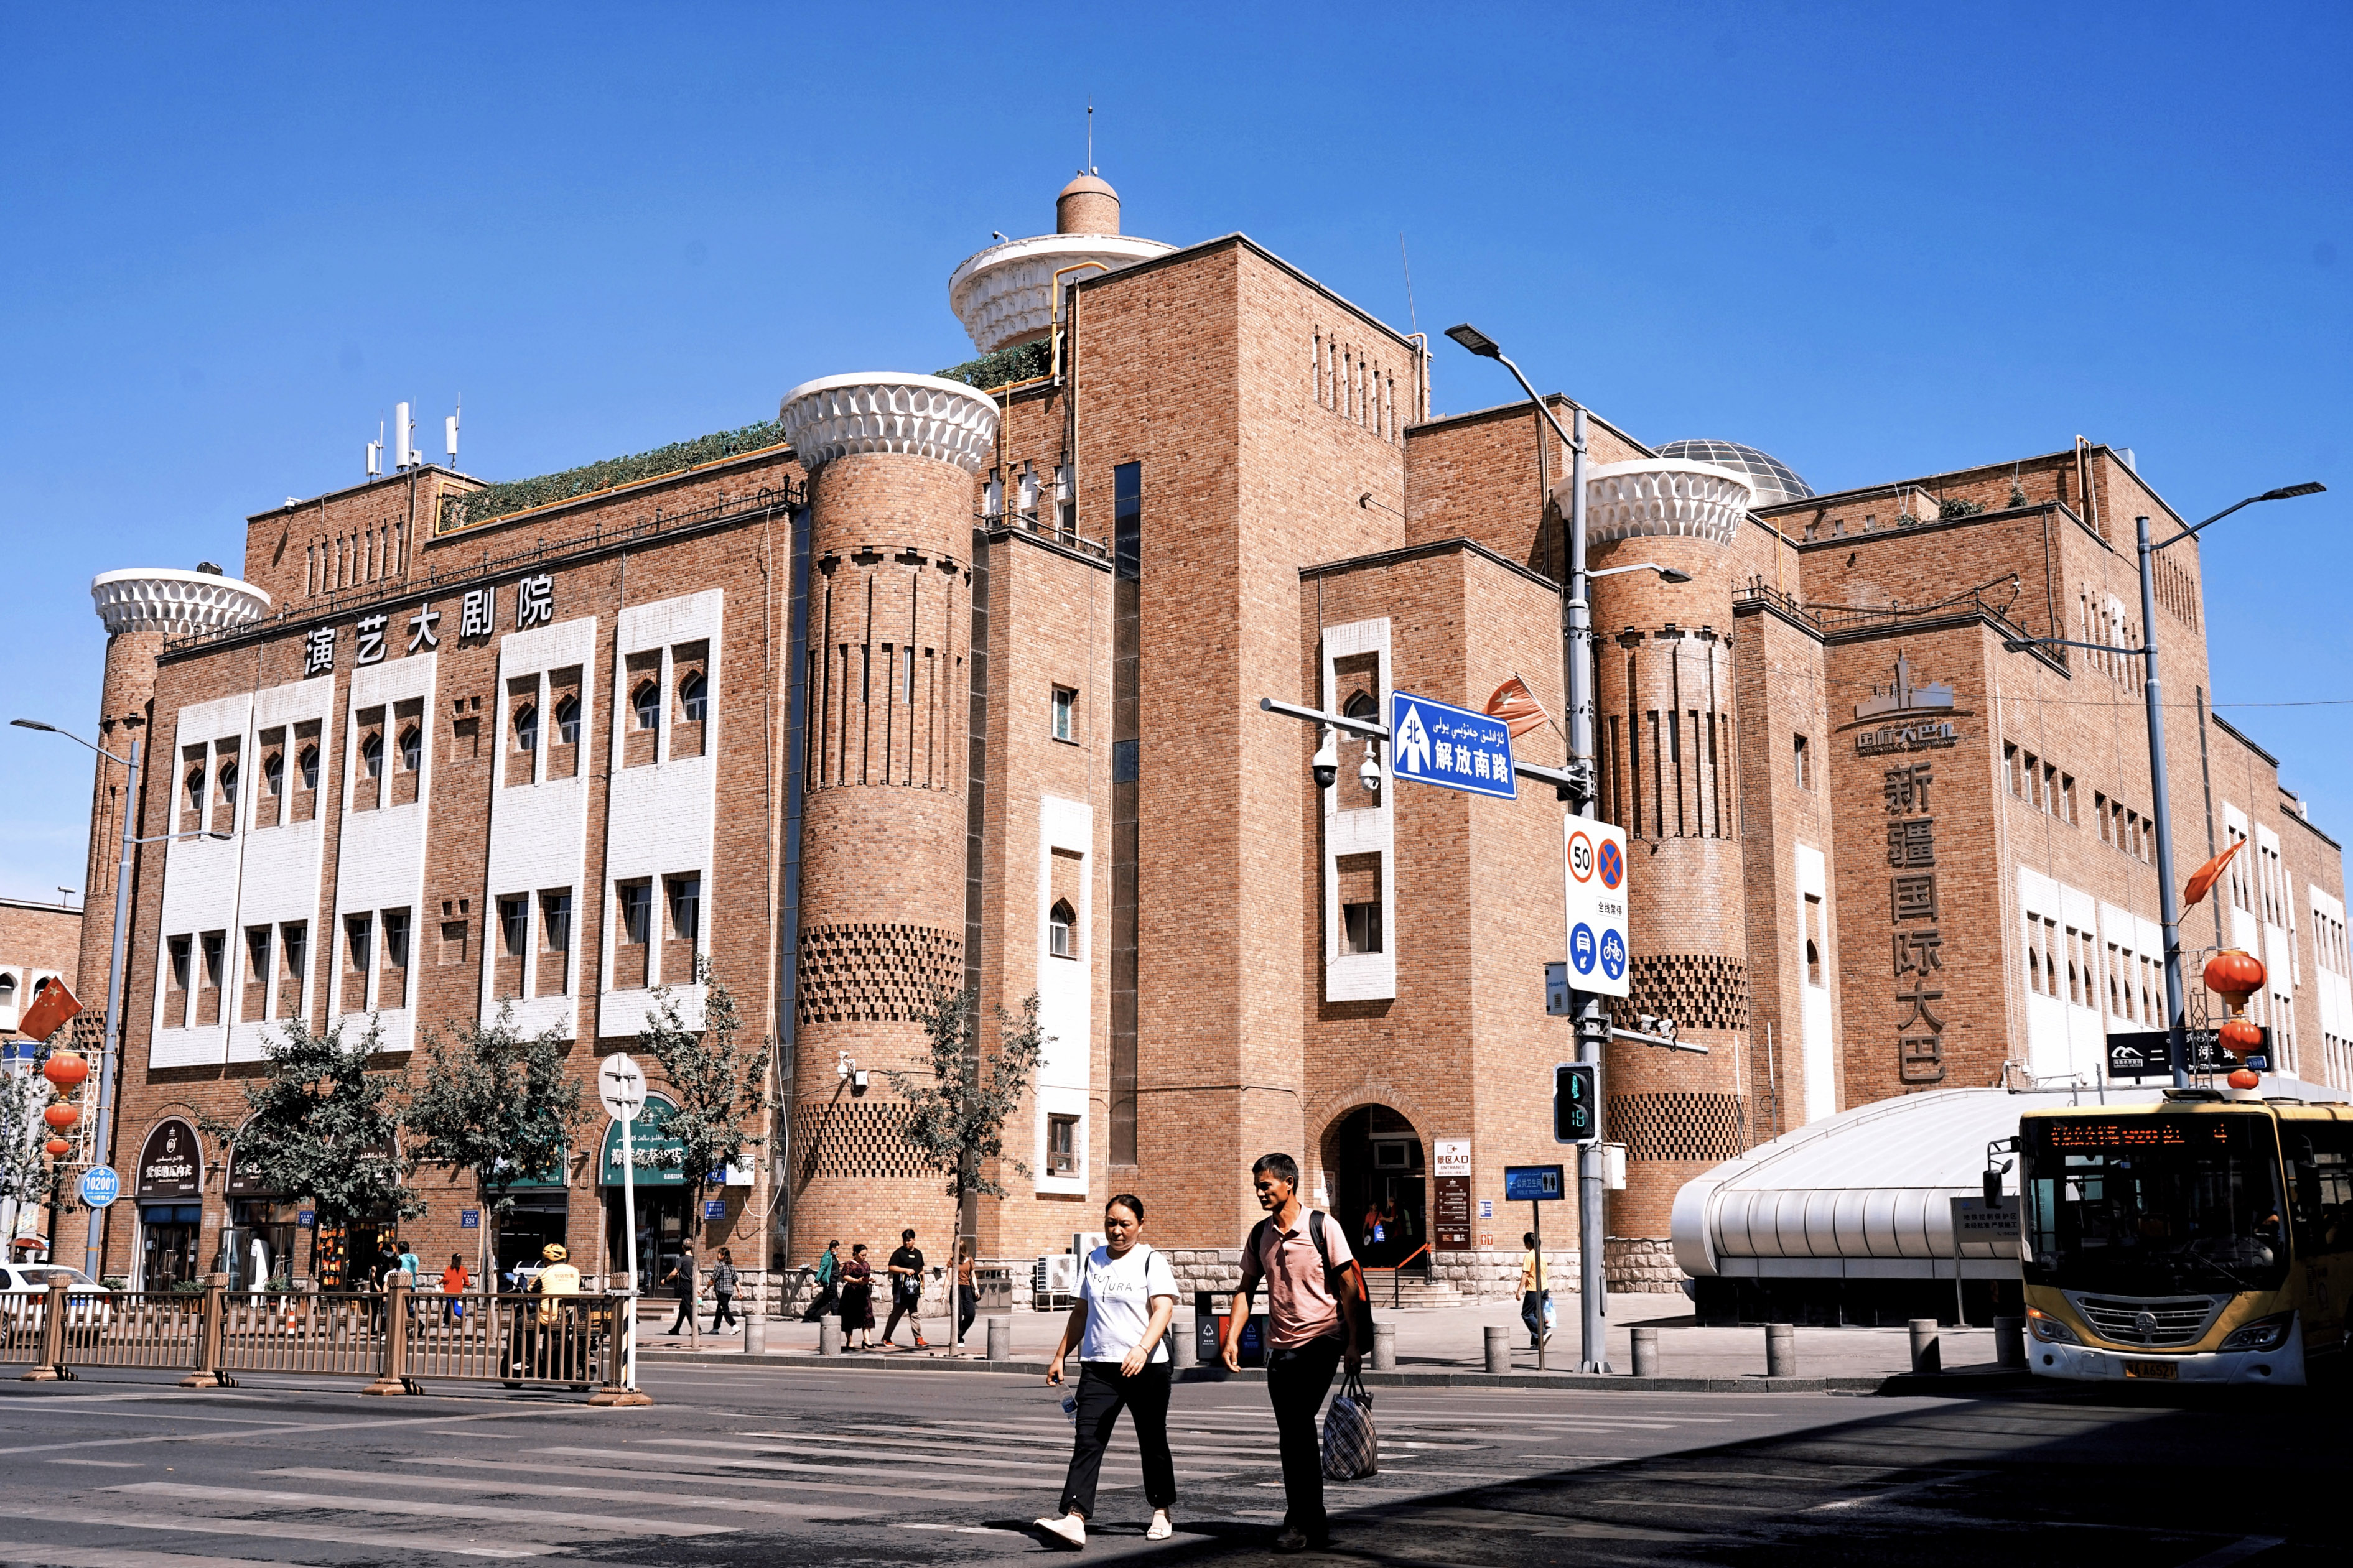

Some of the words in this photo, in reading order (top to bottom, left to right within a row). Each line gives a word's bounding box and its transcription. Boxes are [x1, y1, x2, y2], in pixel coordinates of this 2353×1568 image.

[304, 573, 554, 675] 演艺大剧院
[1407, 719, 1420, 745] 北
[1857, 723, 1959, 748] 国际大巴扎
[1434, 739, 1509, 784] 解放南路
[1574, 846, 1590, 870] 50
[1598, 901, 1622, 917] 全线禁停
[1883, 761, 1946, 1093] 新疆国际大巴
[1437, 1155, 1468, 1164] 景区入口
[86, 1177, 115, 1190] 102001
[1517, 1179, 1542, 1188] 公共卫生间
